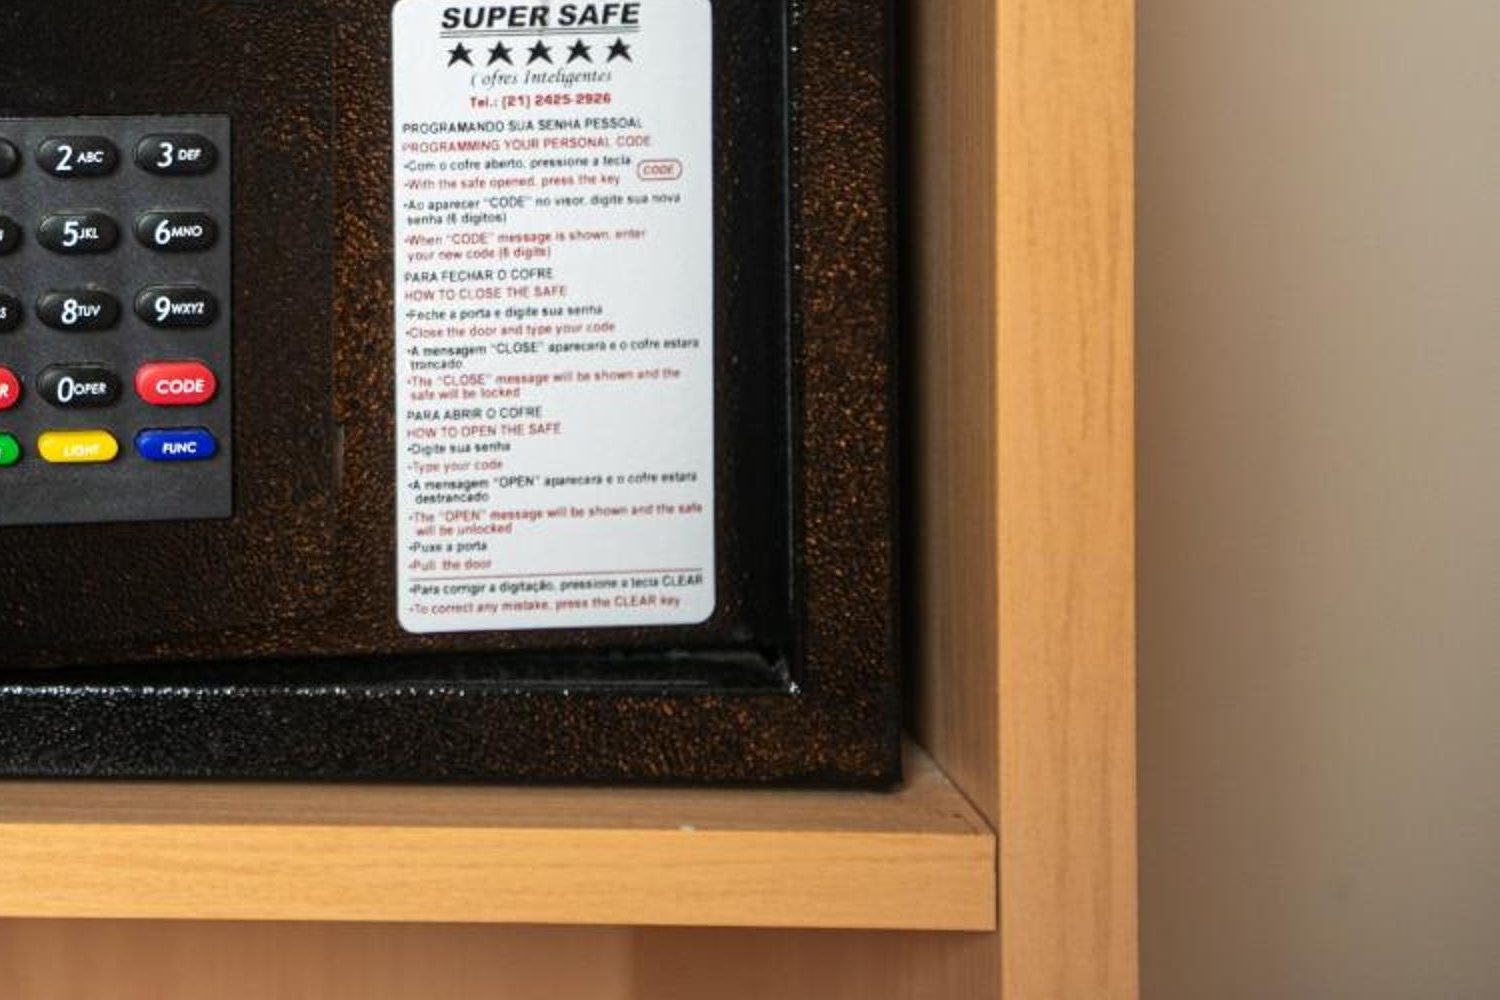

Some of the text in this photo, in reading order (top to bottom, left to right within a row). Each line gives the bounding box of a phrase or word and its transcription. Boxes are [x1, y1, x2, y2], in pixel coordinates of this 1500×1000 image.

[440, 2, 640, 30] SUPER SAFE
[523, 66, 610, 88] Inteligentes
[501, 94, 530, 110] (21)
[401, 116, 642, 135] PROGRAMANDO SUA SENHA PESSOAL
[401, 135, 649, 153] PROGRAMMING YOUR PERSONAL CODE
[56, 145, 103, 170] 2 ABC
[158, 142, 201, 167] 3 DEF
[439, 161, 446, 170] o
[449, 158, 480, 170] cofre
[529, 157, 589, 169] pressione
[592, 157, 599, 166] a
[602, 154, 631, 166] tecla
[643, 162, 676, 175] CODE
[438, 179, 456, 188] the
[460, 176, 486, 188] safe
[541, 176, 574, 188] press
[578, 173, 596, 184] the
[600, 174, 619, 186] key
[63, 221, 98, 246] 5 JKL
[155, 220, 202, 244] 6 MNO
[497, 232, 551, 245] message
[555, 232, 565, 241] is
[615, 229, 644, 238] enter
[408, 251, 434, 262] your
[438, 250, 462, 260] new
[465, 248, 494, 259] code
[513, 244, 550, 260] digits)
[403, 266, 552, 283] PARA FECHAR O COFRE
[404, 285, 564, 302] HOW TO CLOSE THE SAFE
[62, 299, 100, 323] 8 TUV
[155, 296, 204, 320] 9 WXYZ
[449, 310, 456, 319] a
[459, 308, 491, 320] porta
[493, 309, 501, 318] e
[505, 305, 538, 320] digite
[541, 306, 563, 316] sua
[567, 305, 602, 316] senha
[446, 326, 465, 336] the
[469, 324, 496, 336] door
[500, 324, 522, 336] and
[526, 324, 552, 336] type
[555, 324, 582, 334] your
[586, 321, 614, 332] code
[495, 374, 549, 386] message
[553, 372, 572, 381] will
[576, 371, 590, 381] be
[594, 369, 633, 380] shown
[637, 369, 659, 379] and
[662, 368, 680, 377] the
[58, 377, 106, 402] 0 OPER
[156, 379, 204, 394] CODE
[410, 387, 520, 400] safe will be locked
[406, 405, 541, 421] PARA ABRIR O COFRE
[406, 422, 560, 438] HOW TO OPEN THE SAFE
[163, 442, 196, 453] FUNC
[449, 443, 471, 453] sua
[474, 440, 510, 452] senha
[443, 462, 470, 473] your
[474, 459, 502, 470] code
[414, 489, 489, 504] destrancado
[489, 509, 543, 522] message
[546, 507, 566, 517] will
[570, 506, 584, 517] be
[588, 505, 627, 516] shown
[631, 504, 653, 515] and
[656, 503, 674, 514] the
[678, 503, 702, 513] safe
[416, 522, 512, 536] will be unlocked
[446, 543, 452, 552] a
[456, 540, 487, 552] porta
[442, 559, 460, 570] the
[464, 558, 491, 569] door
[442, 584, 485, 597] corrigir
[488, 583, 496, 592] a
[559, 579, 617, 592] pressione
[621, 579, 628, 588] a
[630, 576, 658, 588] tecla
[661, 574, 702, 586] CLEAR
[431, 602, 473, 614] correct
[476, 603, 498, 613] any
[555, 599, 588, 610] press
[591, 597, 610, 607] the
[614, 594, 656, 607] CLEAR
[660, 595, 679, 606] key
